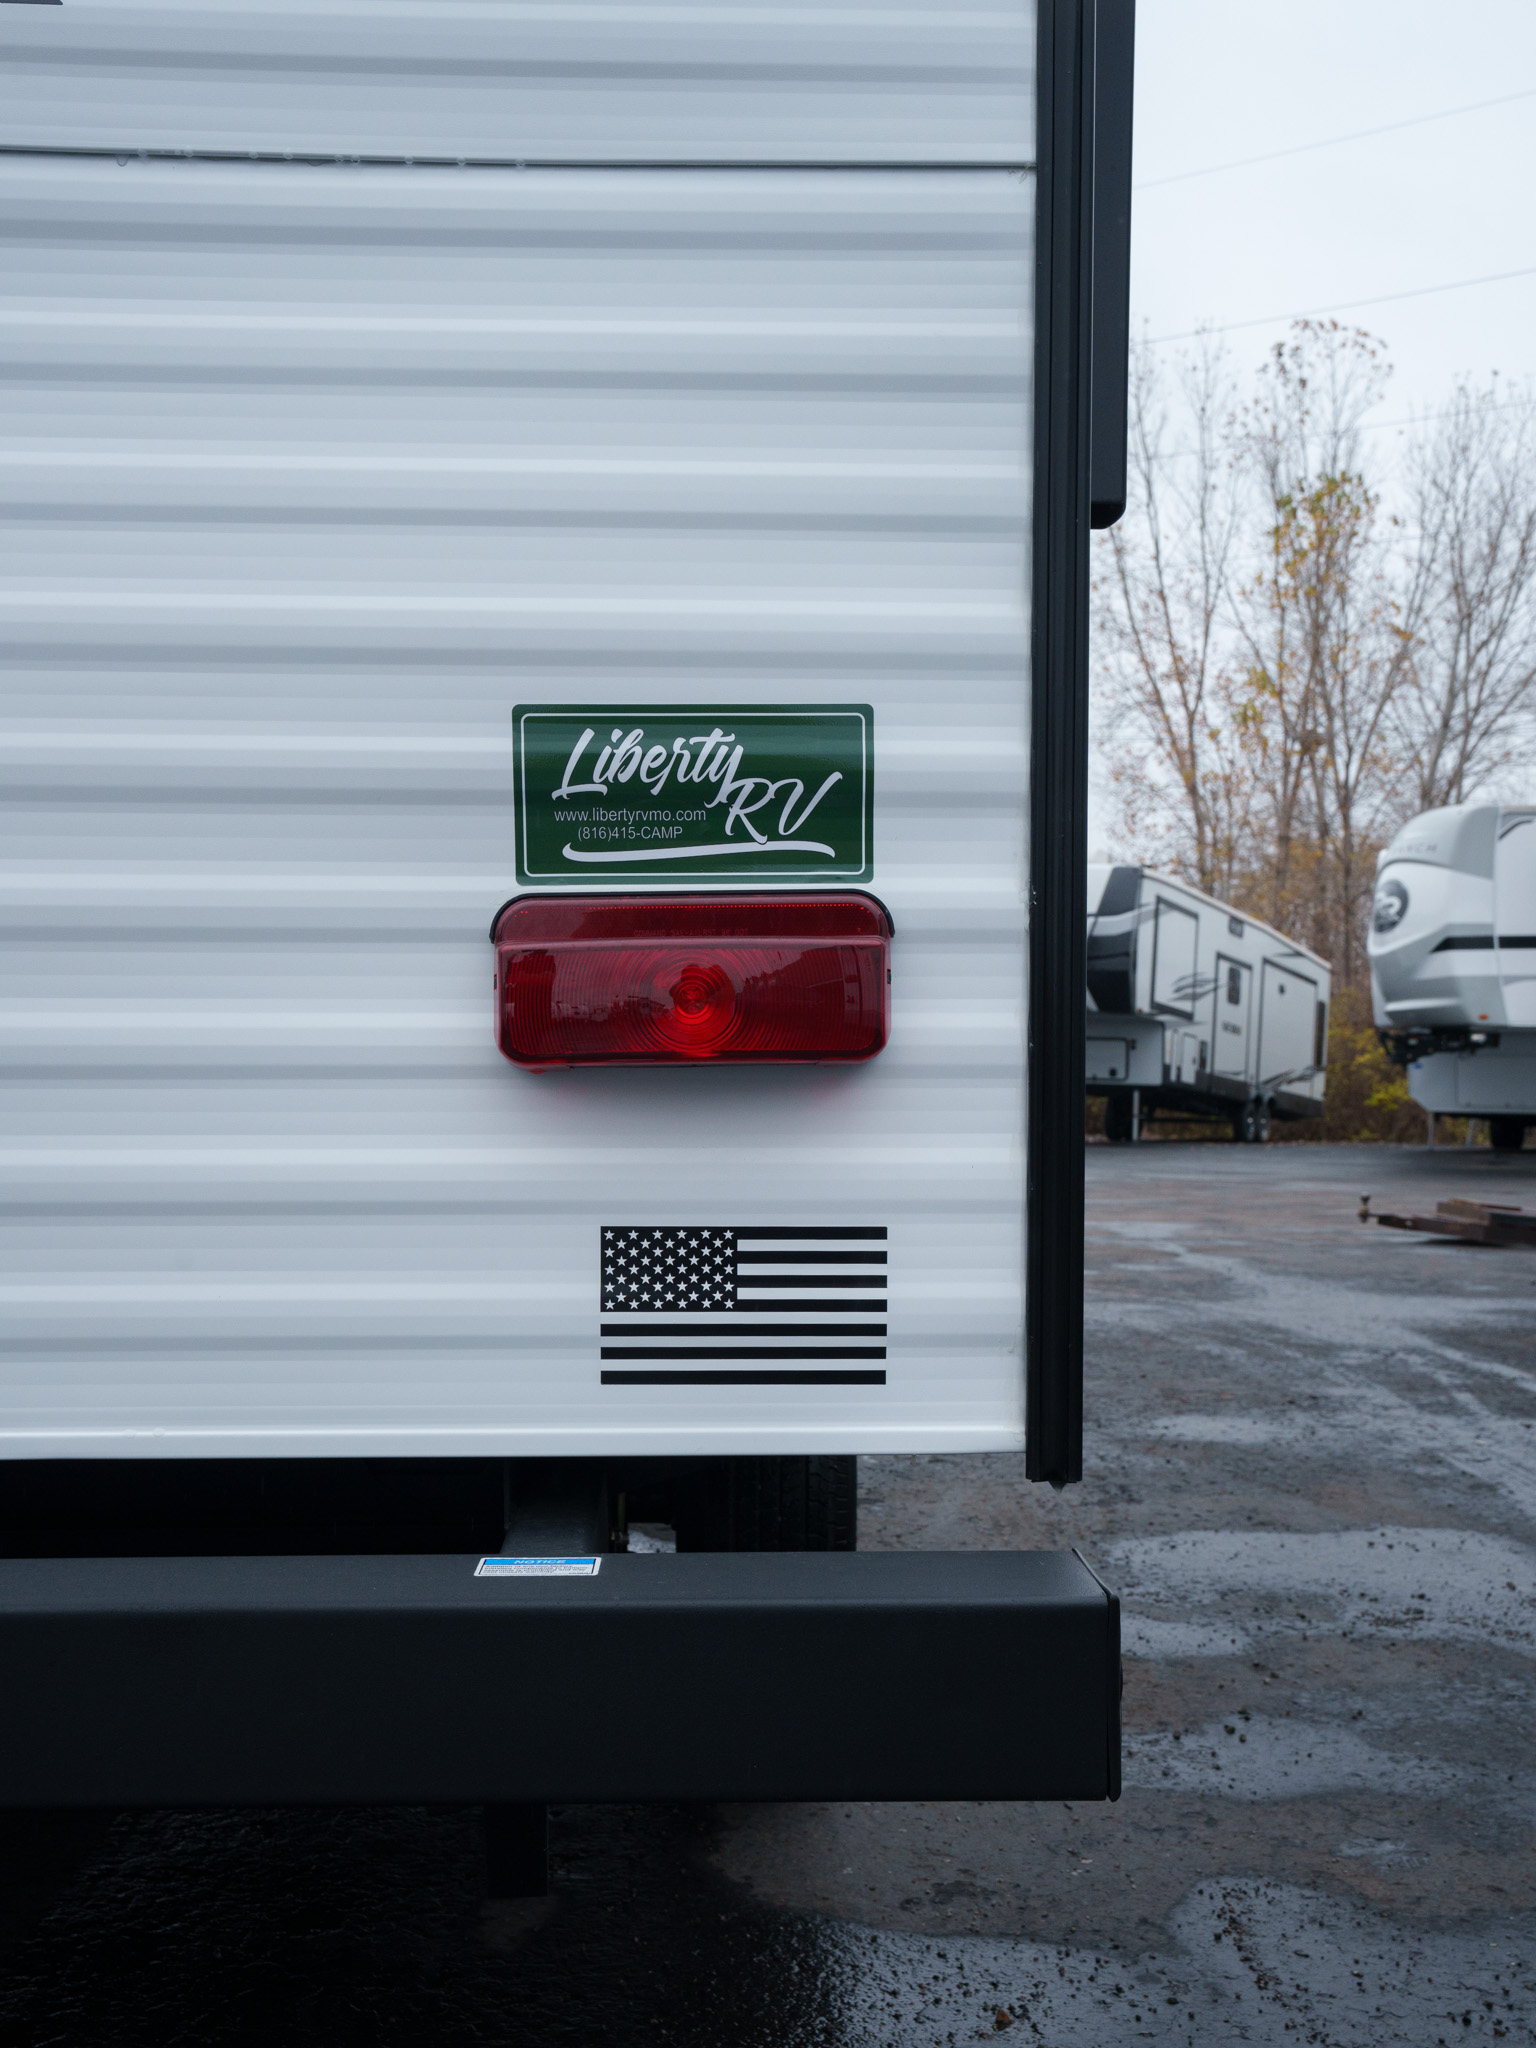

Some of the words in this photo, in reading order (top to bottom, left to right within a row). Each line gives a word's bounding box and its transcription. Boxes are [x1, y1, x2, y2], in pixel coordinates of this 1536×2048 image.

[551, 727, 745, 809] Liberty
[554, 807, 707, 825] www.libertyrvmo.com
[724, 771, 843, 845] RV
[578, 826, 683, 841] (816)415-CAMP
